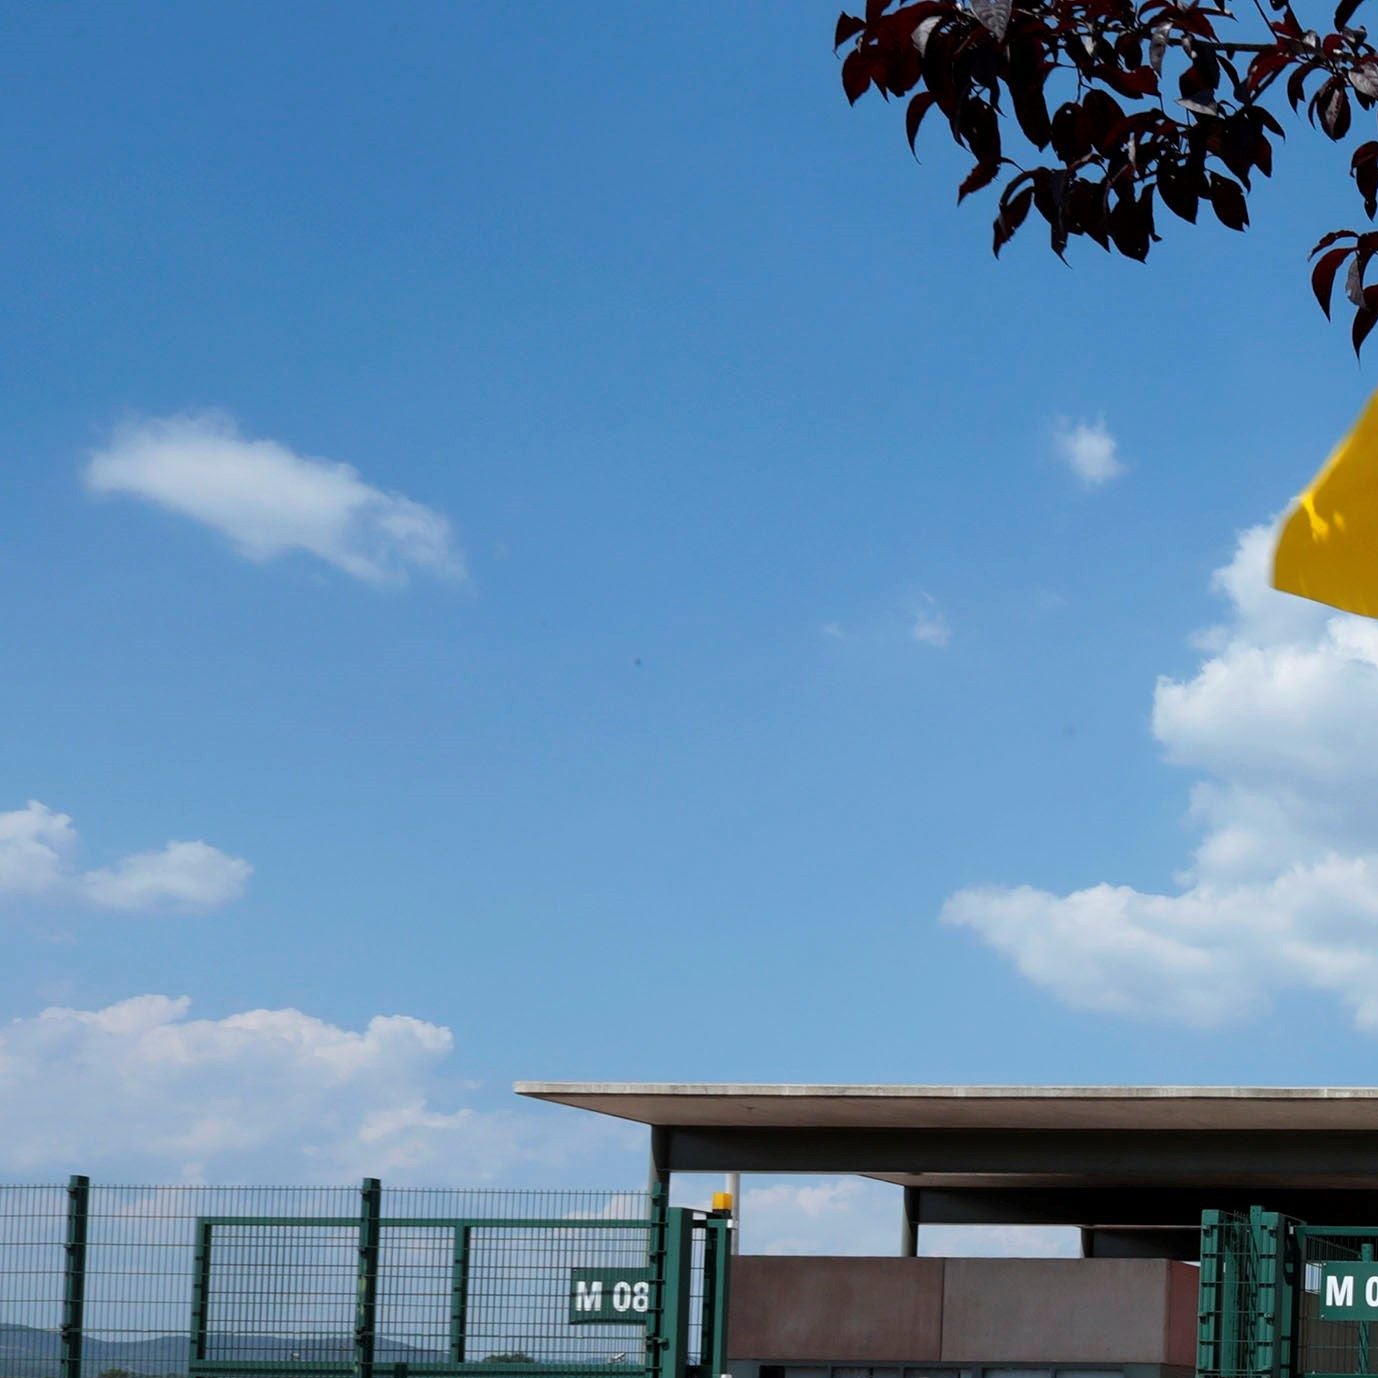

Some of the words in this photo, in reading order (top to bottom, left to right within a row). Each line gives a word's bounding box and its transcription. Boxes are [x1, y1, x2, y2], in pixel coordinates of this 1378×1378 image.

[576, 1281, 602, 1311] M
[613, 1281, 649, 1312] 08
[1326, 1276, 1354, 1306] M
